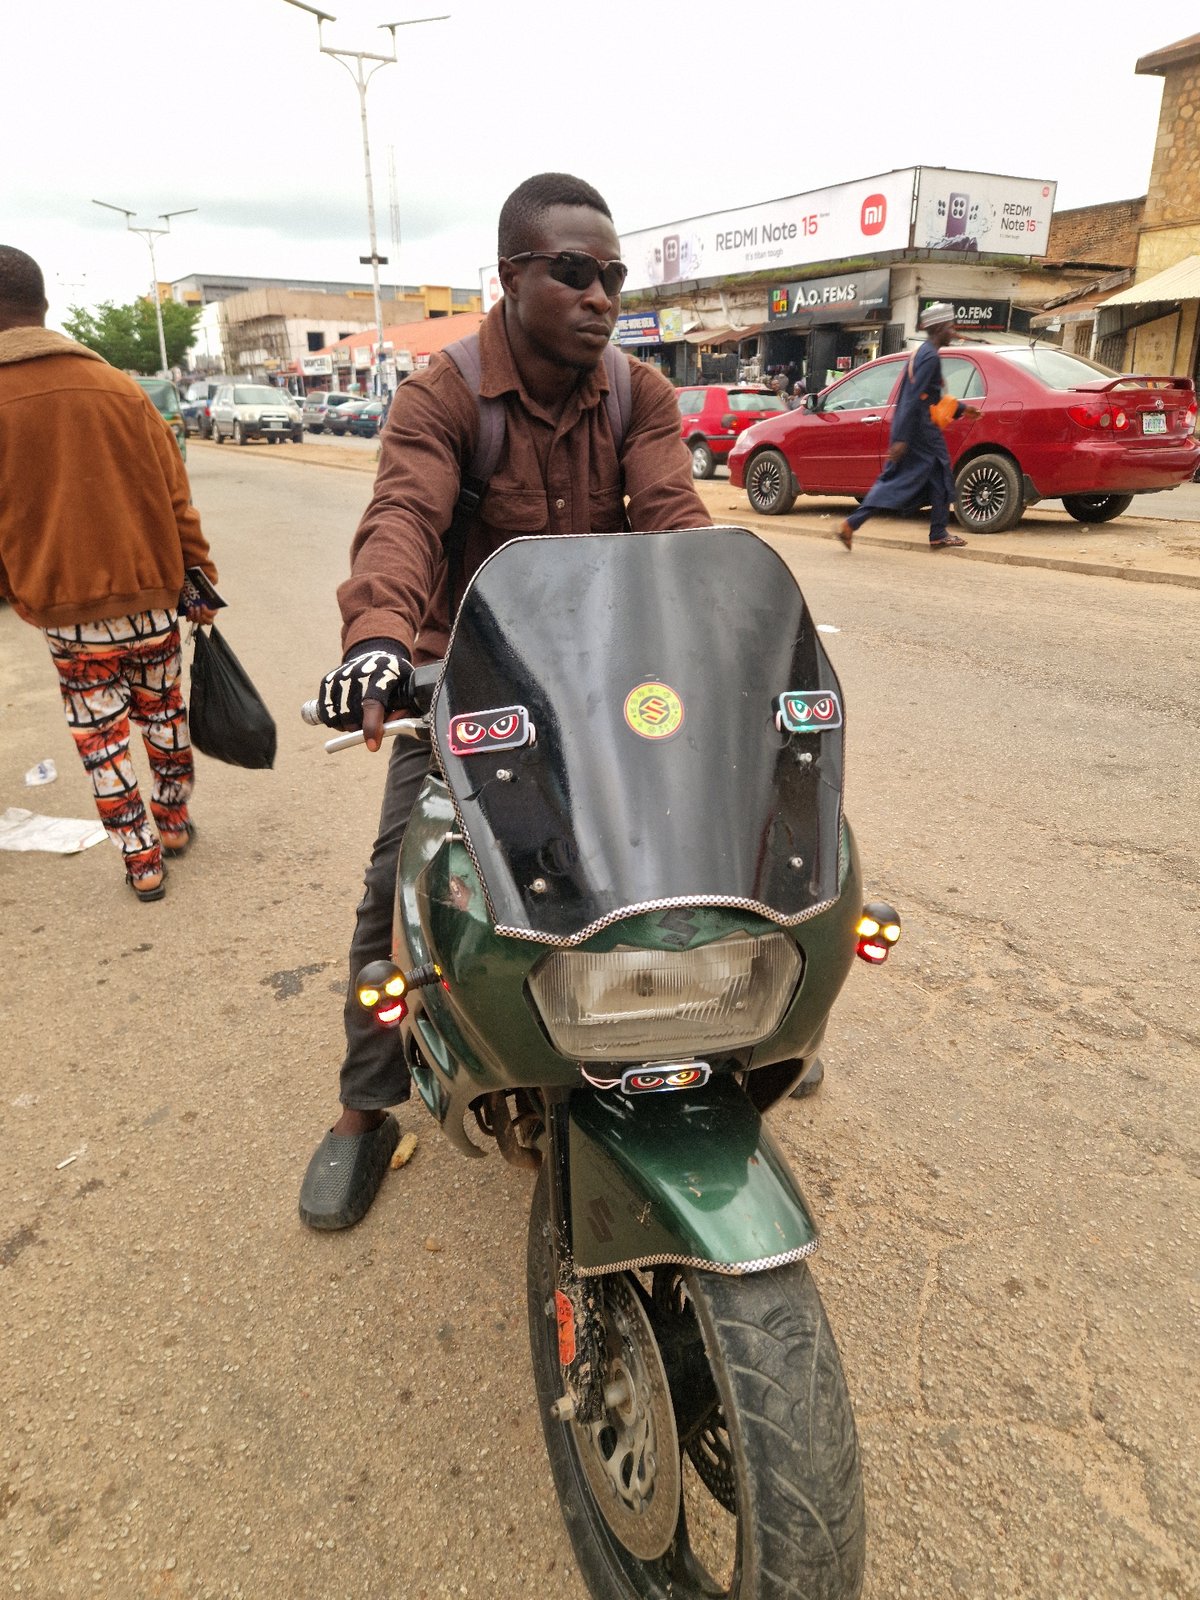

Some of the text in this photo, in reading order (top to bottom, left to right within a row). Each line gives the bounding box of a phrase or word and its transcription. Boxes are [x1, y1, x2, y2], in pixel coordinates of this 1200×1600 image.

[1003, 203, 1032, 217] REDMI
[1001, 217, 1036, 232] Note 15
[716, 214, 818, 251] REDMI Note 15
[822, 283, 856, 304] FEMS
[968, 306, 993, 319] FEMS
